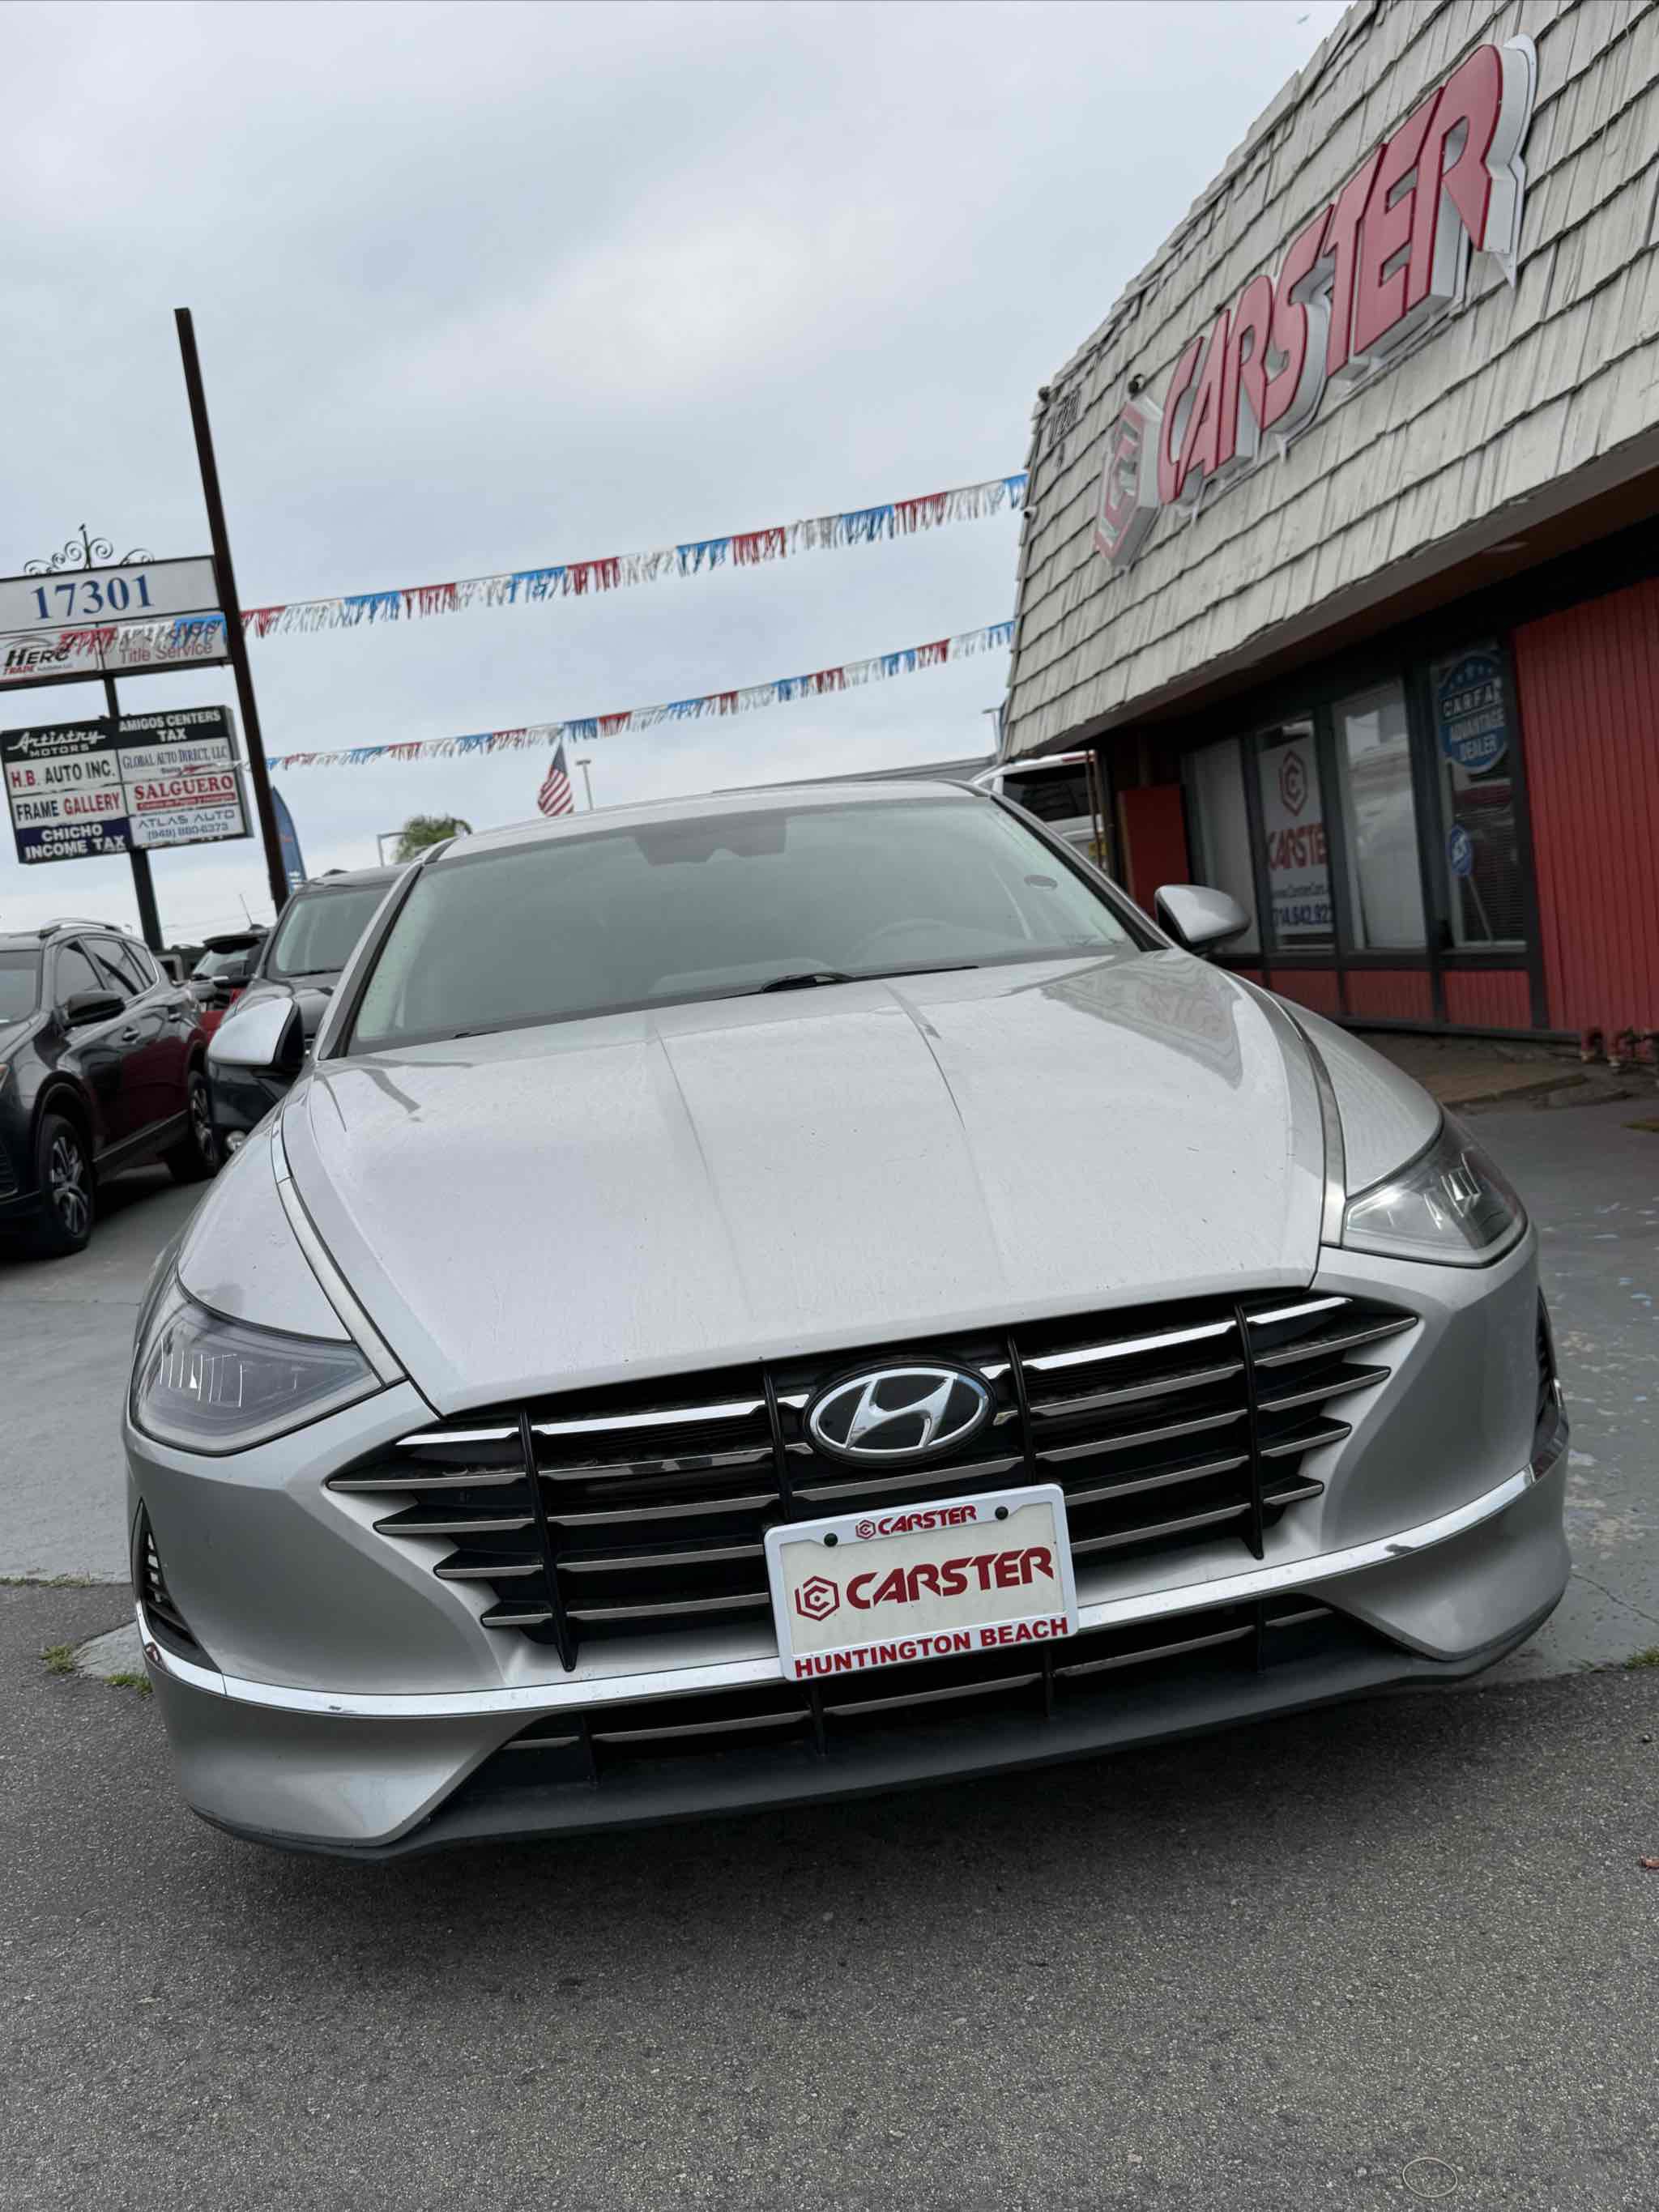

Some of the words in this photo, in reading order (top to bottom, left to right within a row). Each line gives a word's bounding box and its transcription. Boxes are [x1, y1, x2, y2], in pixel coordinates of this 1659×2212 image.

[1158, 42, 1513, 506] CARSTER
[31, 573, 155, 620] 17301
[156, 641, 213, 660] Service
[119, 717, 164, 733] AMIGOS
[166, 710, 221, 728] CENTERS
[7, 728, 106, 753] Artistry
[157, 728, 187, 743] TAX
[29, 744, 89, 758] MOTORS
[123, 752, 155, 769] GLOBAL
[1460, 734, 1498, 763] DEALER
[11, 769, 40, 788] H.B.
[45, 762, 80, 785] AUTO
[85, 760, 116, 780] INC.
[134, 775, 234, 800] SALGUERO
[16, 800, 59, 821] FRAME
[64, 792, 120, 816] GALLERY
[139, 815, 188, 829] ATLAS
[194, 810, 235, 821] AUTO
[41, 823, 103, 842] CHICHO
[25, 838, 88, 859] INCOME
[94, 835, 126, 852] TAX
[1269, 824, 1328, 871] CARSTE
[878, 1504, 977, 1536] CARSTER
[846, 1546, 1054, 1609] CARSTER
[795, 1631, 971, 1678] HUNTINGTON
[980, 1617, 1068, 1647] BEACH
